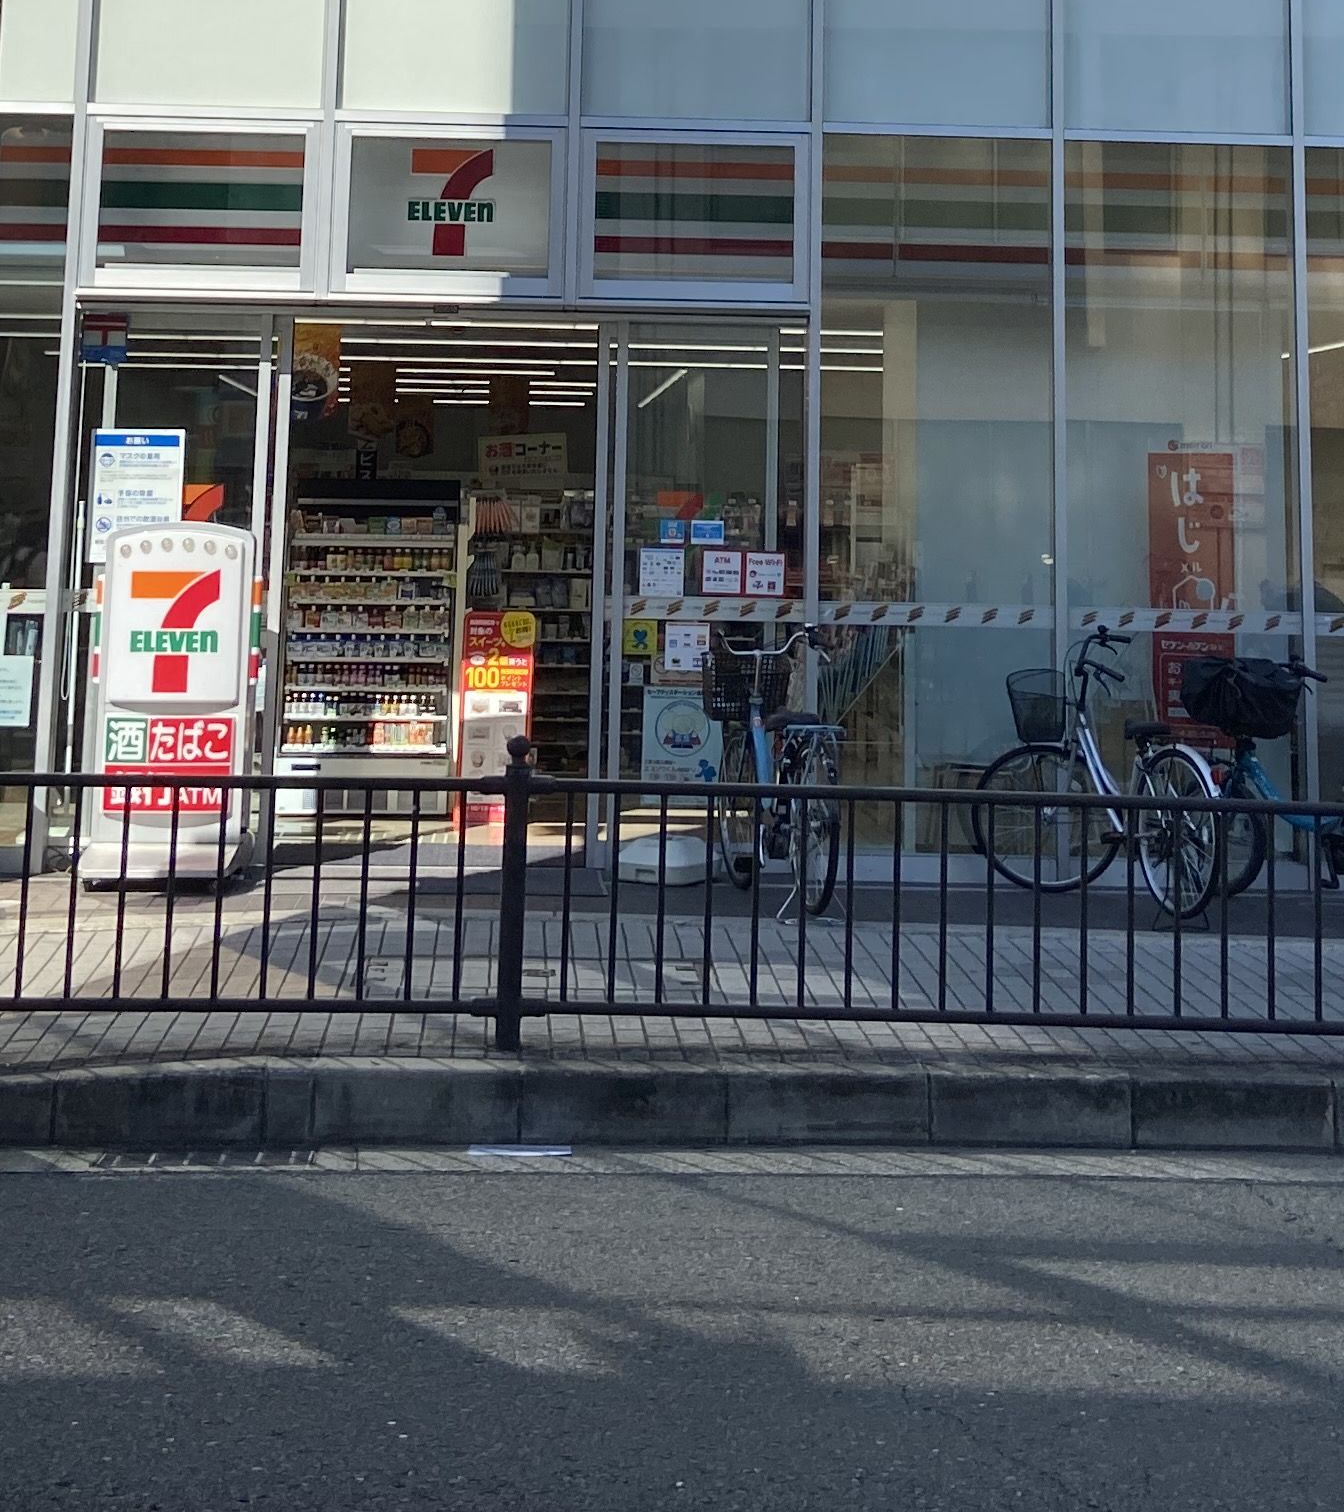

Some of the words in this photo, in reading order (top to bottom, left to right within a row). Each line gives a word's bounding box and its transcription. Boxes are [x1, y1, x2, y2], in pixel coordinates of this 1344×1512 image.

[485, 440, 563, 458] お酒コーナー
[465, 667, 500, 688] 100
[108, 720, 146, 761] 酒
[149, 719, 229, 761] たばこ
